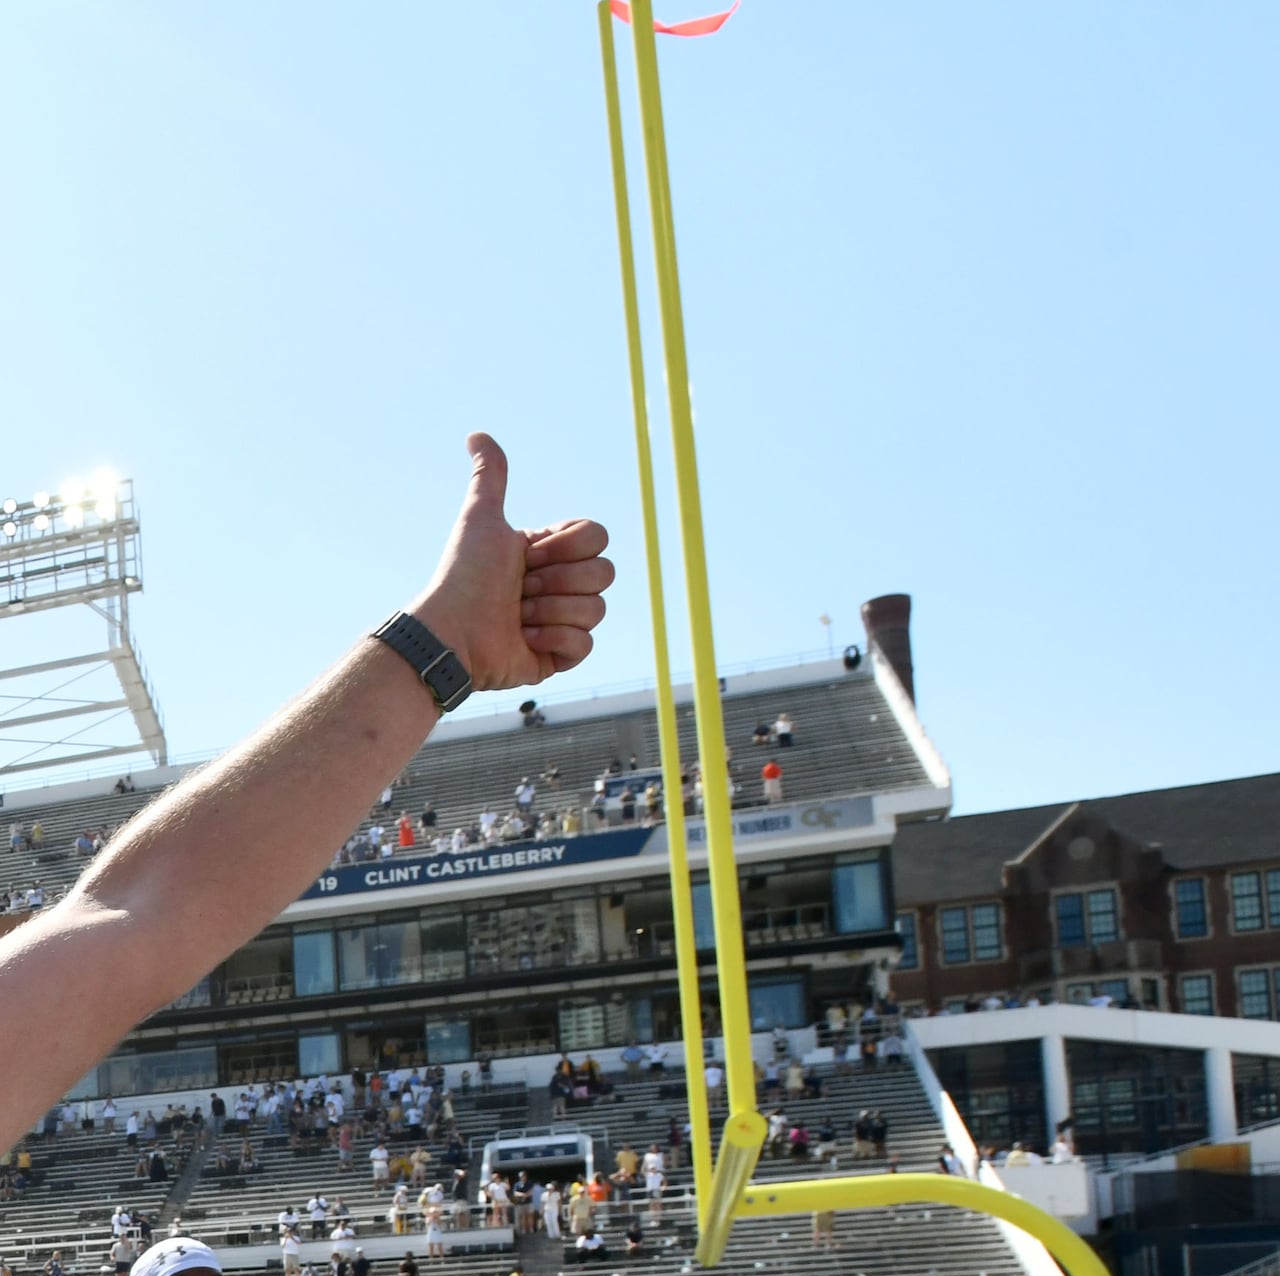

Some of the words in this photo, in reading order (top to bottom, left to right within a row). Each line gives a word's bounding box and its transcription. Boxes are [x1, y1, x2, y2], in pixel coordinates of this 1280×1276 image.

[318, 876, 338, 892] 19
[365, 865, 421, 886] CLINT
[426, 845, 566, 878] CASTLEBERRY
